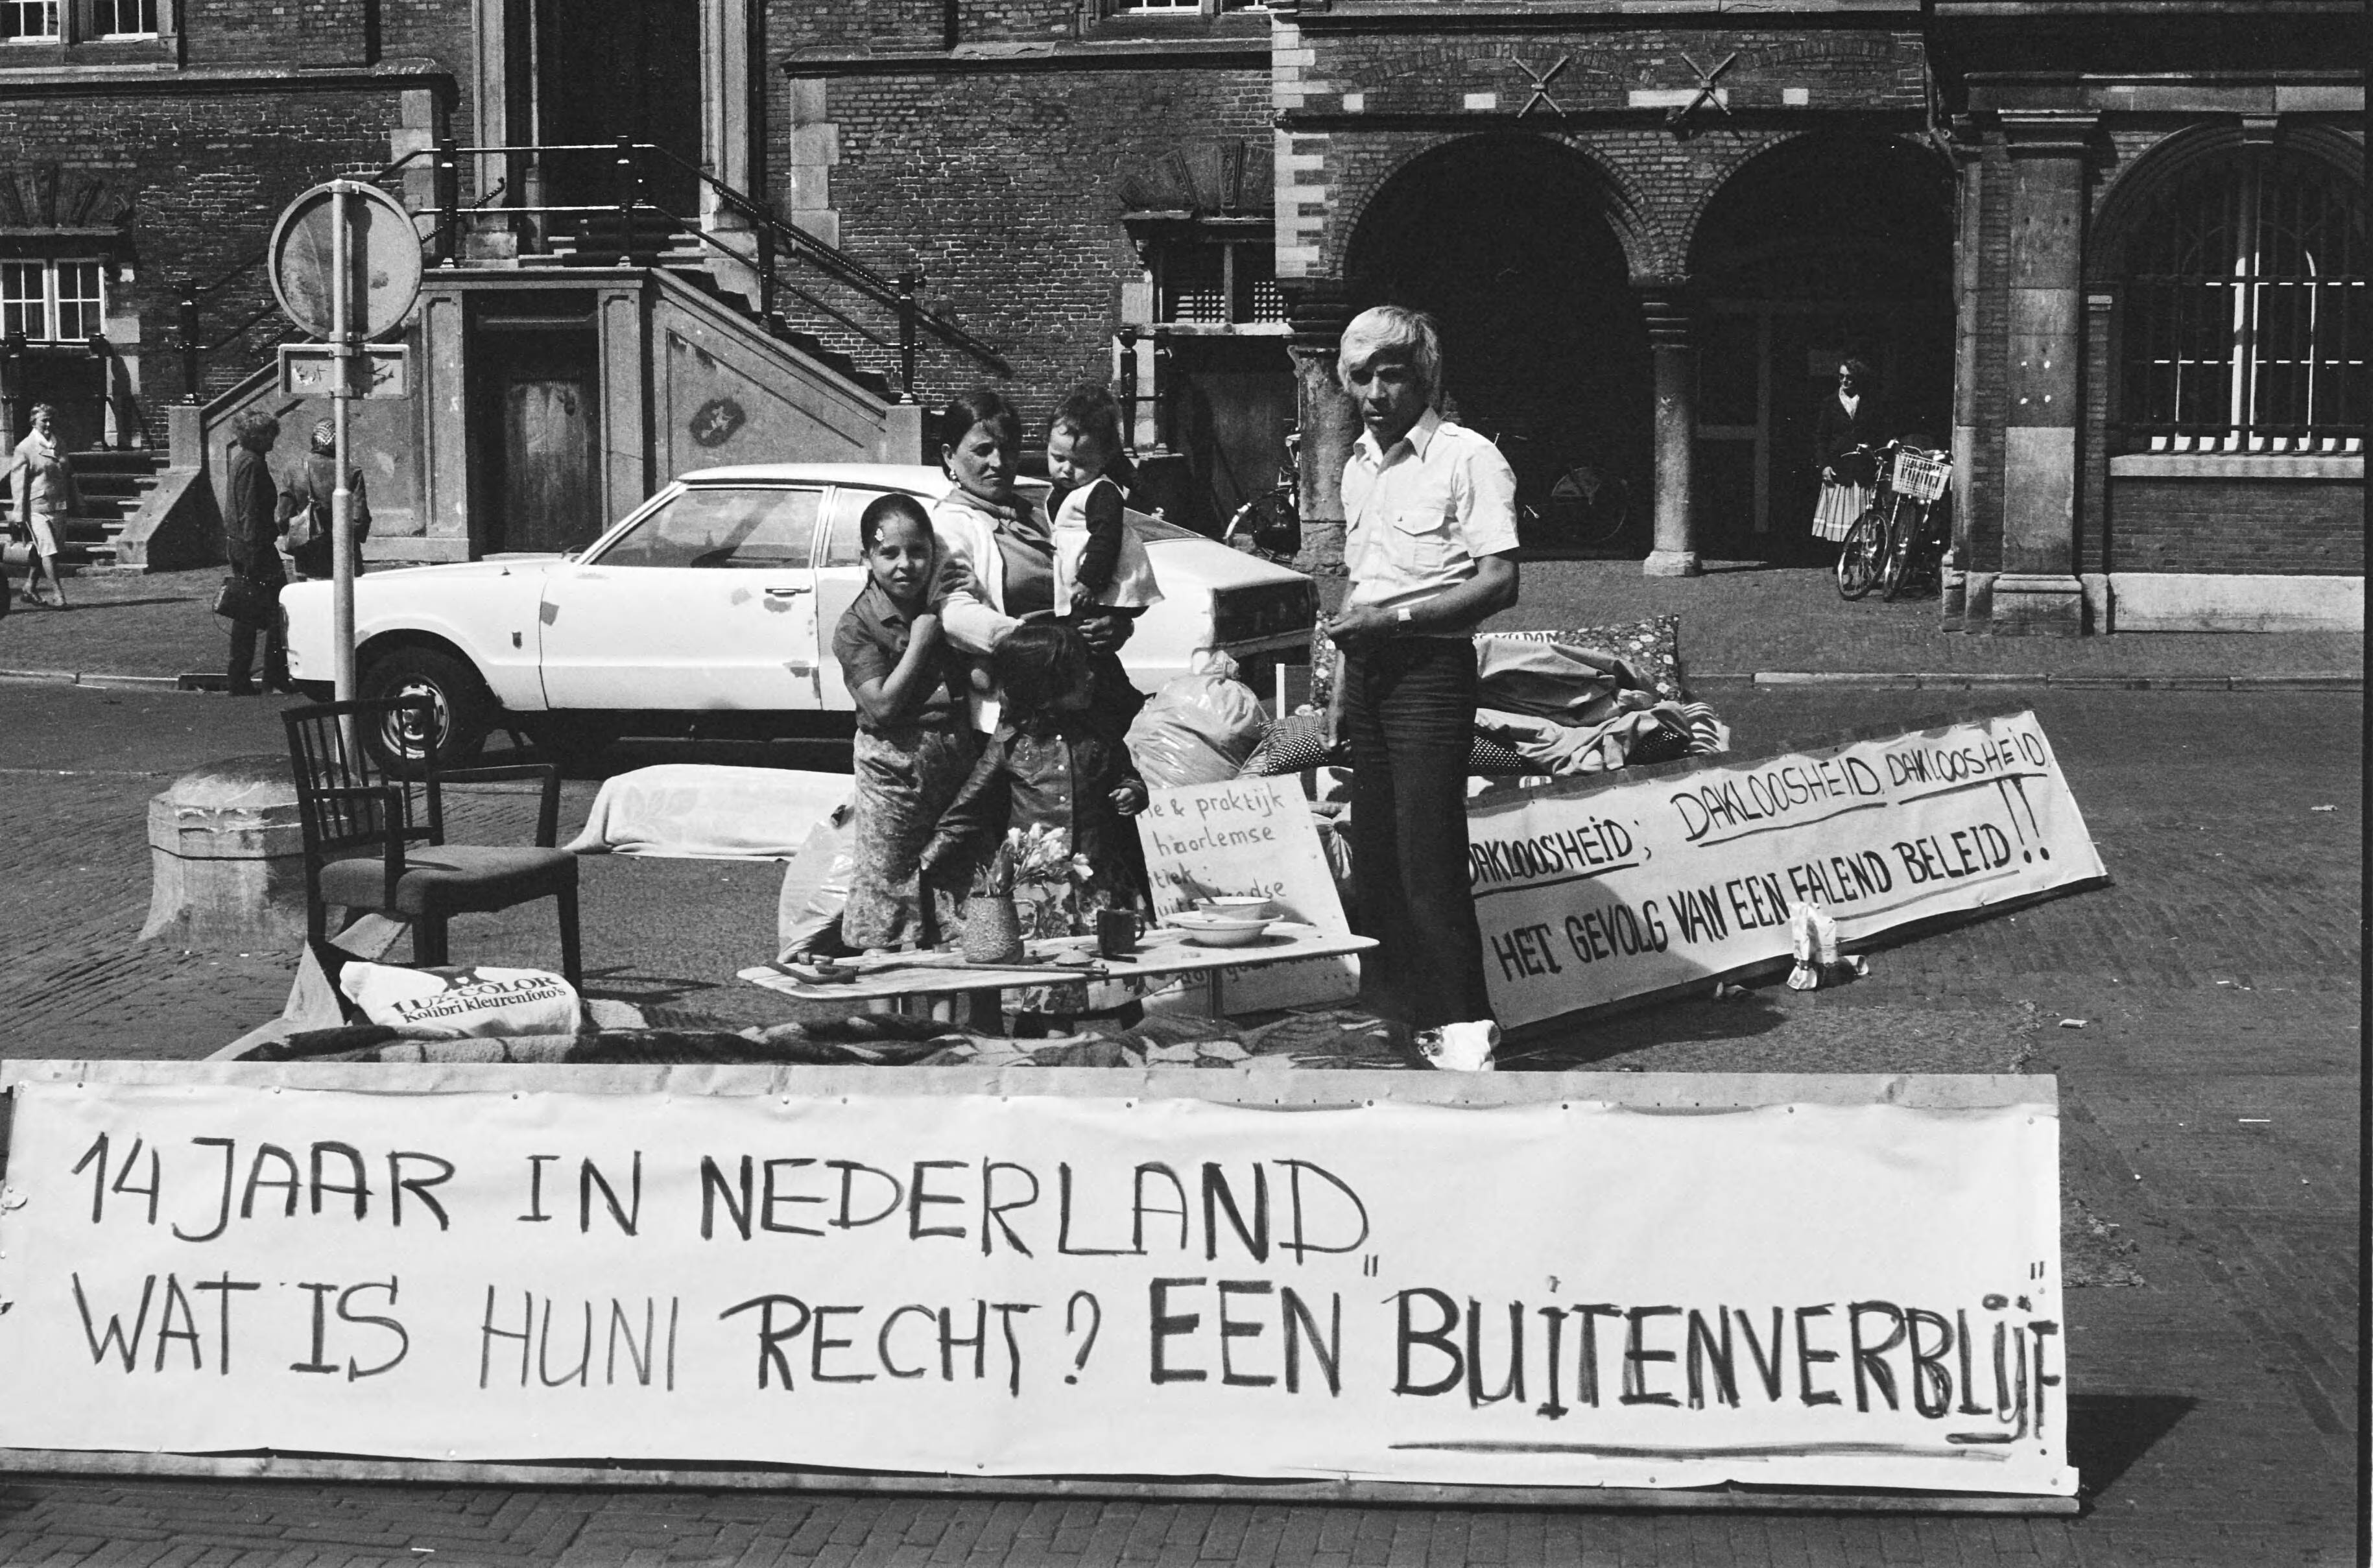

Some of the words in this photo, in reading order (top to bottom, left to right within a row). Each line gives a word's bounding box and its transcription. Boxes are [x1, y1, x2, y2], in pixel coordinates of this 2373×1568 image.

[1171, 798, 1185, 817] &
[1196, 782, 1286, 820] praktijk
[1491, 923, 1562, 982] HET
[1564, 900, 1669, 964] GEVOLG
[1668, 885, 1729, 944] VAN
[1726, 872, 1791, 931] EEN
[1787, 850, 1892, 906] FALEND
[401, 1001, 465, 1023] Kolibri
[71, 1131, 160, 1226] 14
[171, 1136, 454, 1244] JAAR
[517, 1150, 641, 1237] IN
[700, 1153, 1370, 1266] NEDERLAND
[71, 1270, 261, 1376] WAT
[289, 1274, 409, 1383] IS
[718, 1290, 1103, 1397] RECHT?
[1149, 1276, 1342, 1398] EEN
